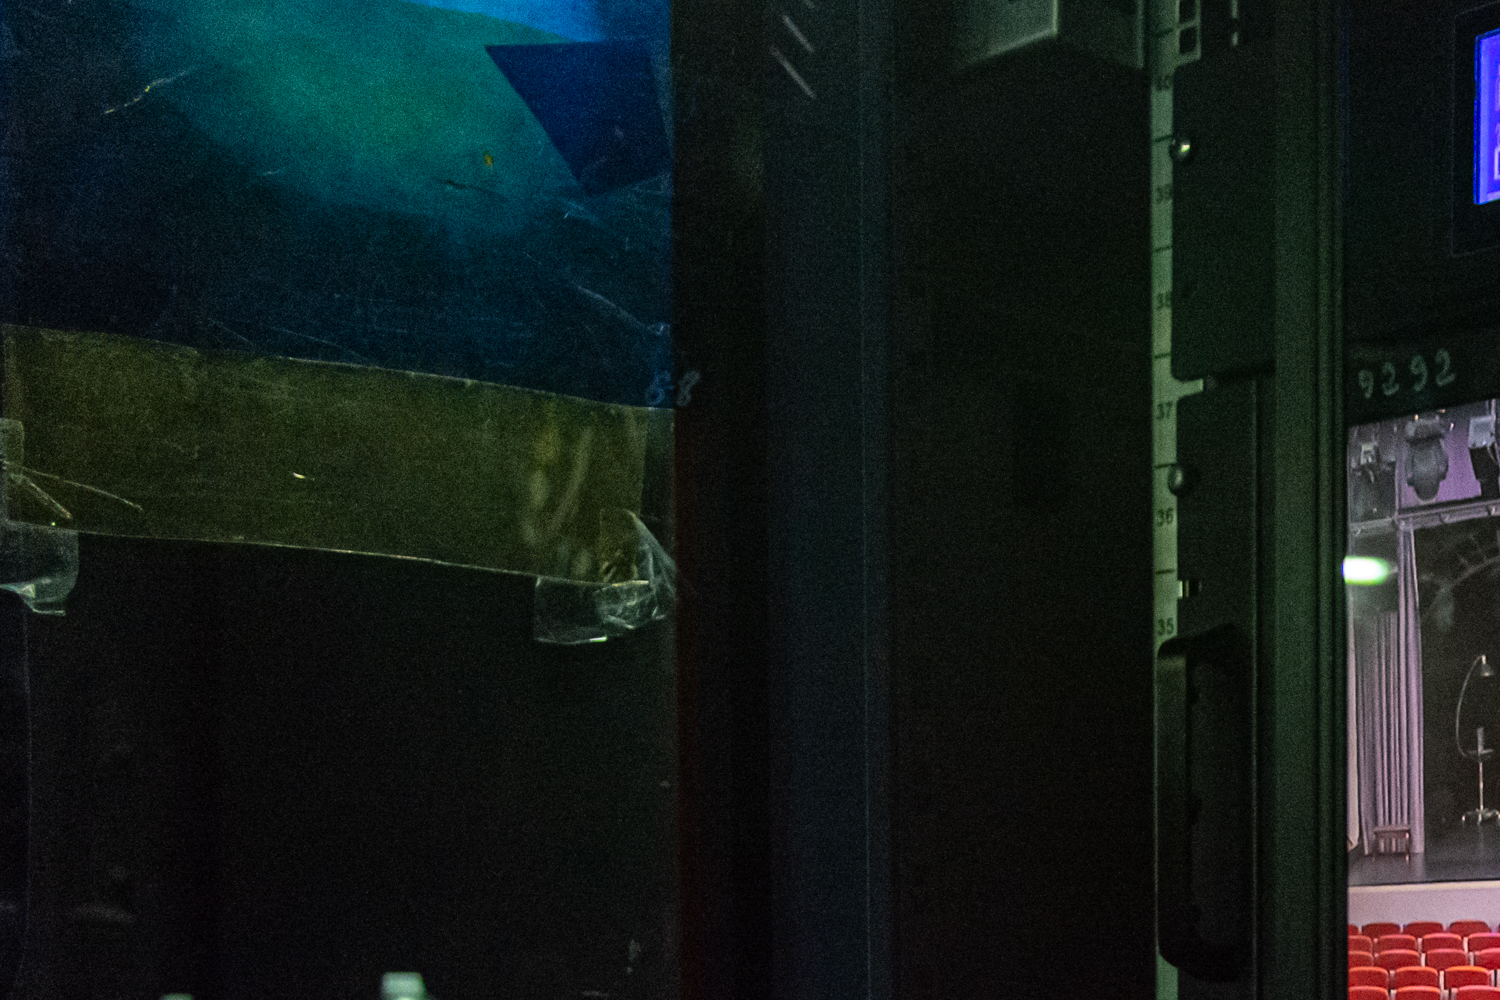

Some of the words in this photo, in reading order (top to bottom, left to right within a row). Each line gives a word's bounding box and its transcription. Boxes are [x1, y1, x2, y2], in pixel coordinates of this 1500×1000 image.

[1157, 402, 1174, 420] 37
[1156, 508, 1174, 527] 36
[1157, 618, 1174, 636] 35
